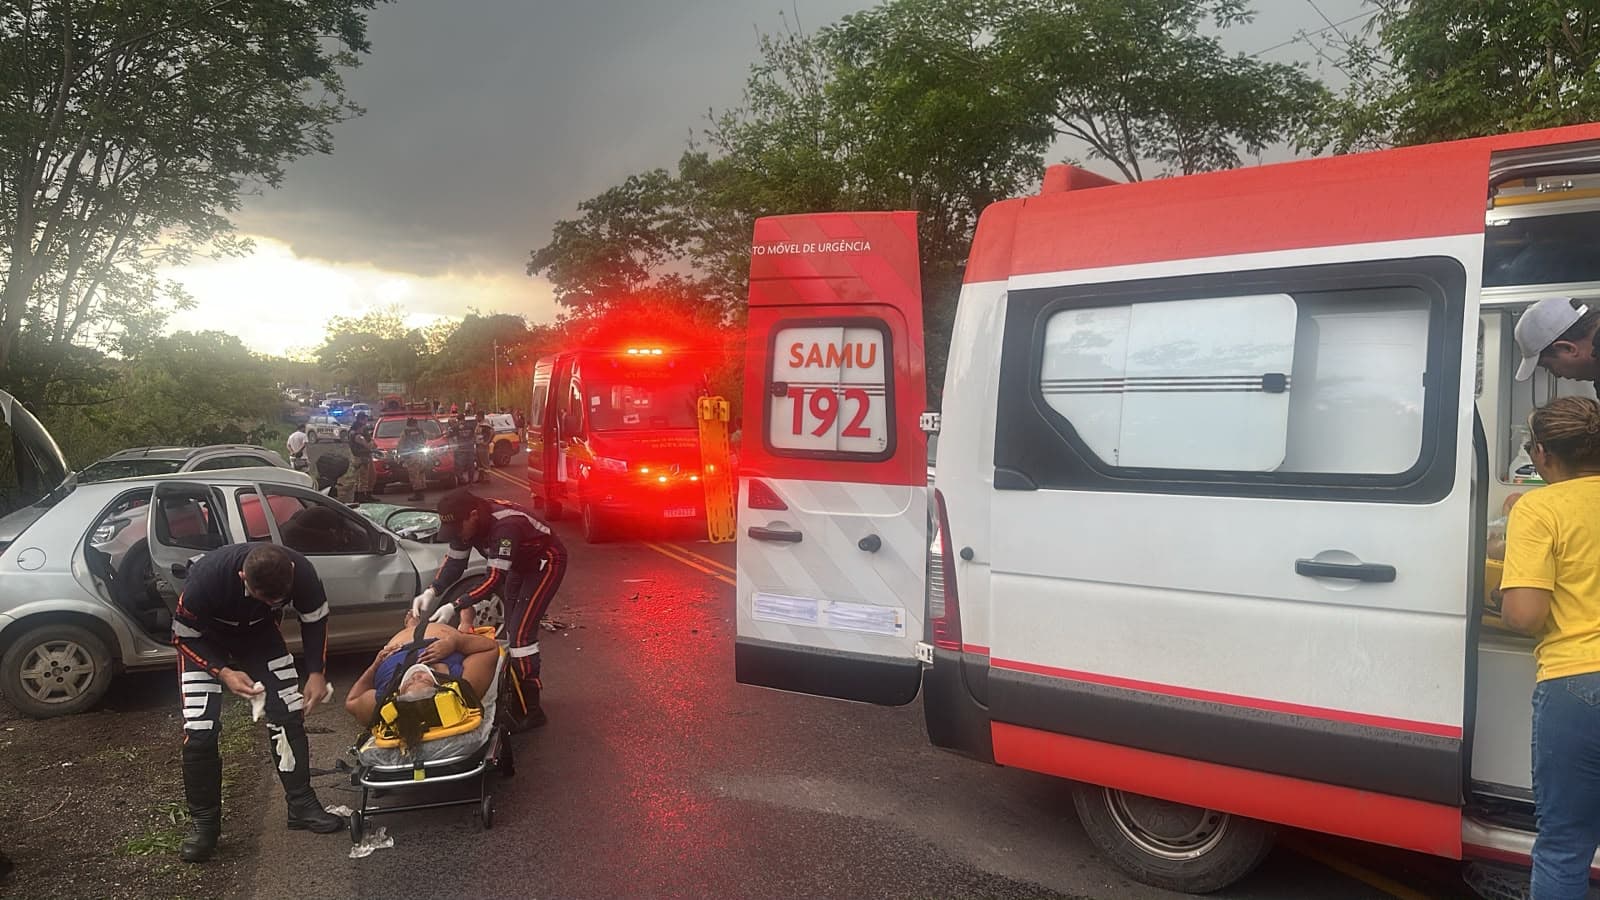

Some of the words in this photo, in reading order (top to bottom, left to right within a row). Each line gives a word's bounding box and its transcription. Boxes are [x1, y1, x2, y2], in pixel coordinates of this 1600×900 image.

[753, 246, 766, 255] TO
[767, 242, 801, 255] MÓVEL
[803, 243, 816, 253] DE
[818, 240, 871, 253] URGÊNCIA
[789, 342, 876, 369] SAMU
[787, 386, 871, 438] 192
